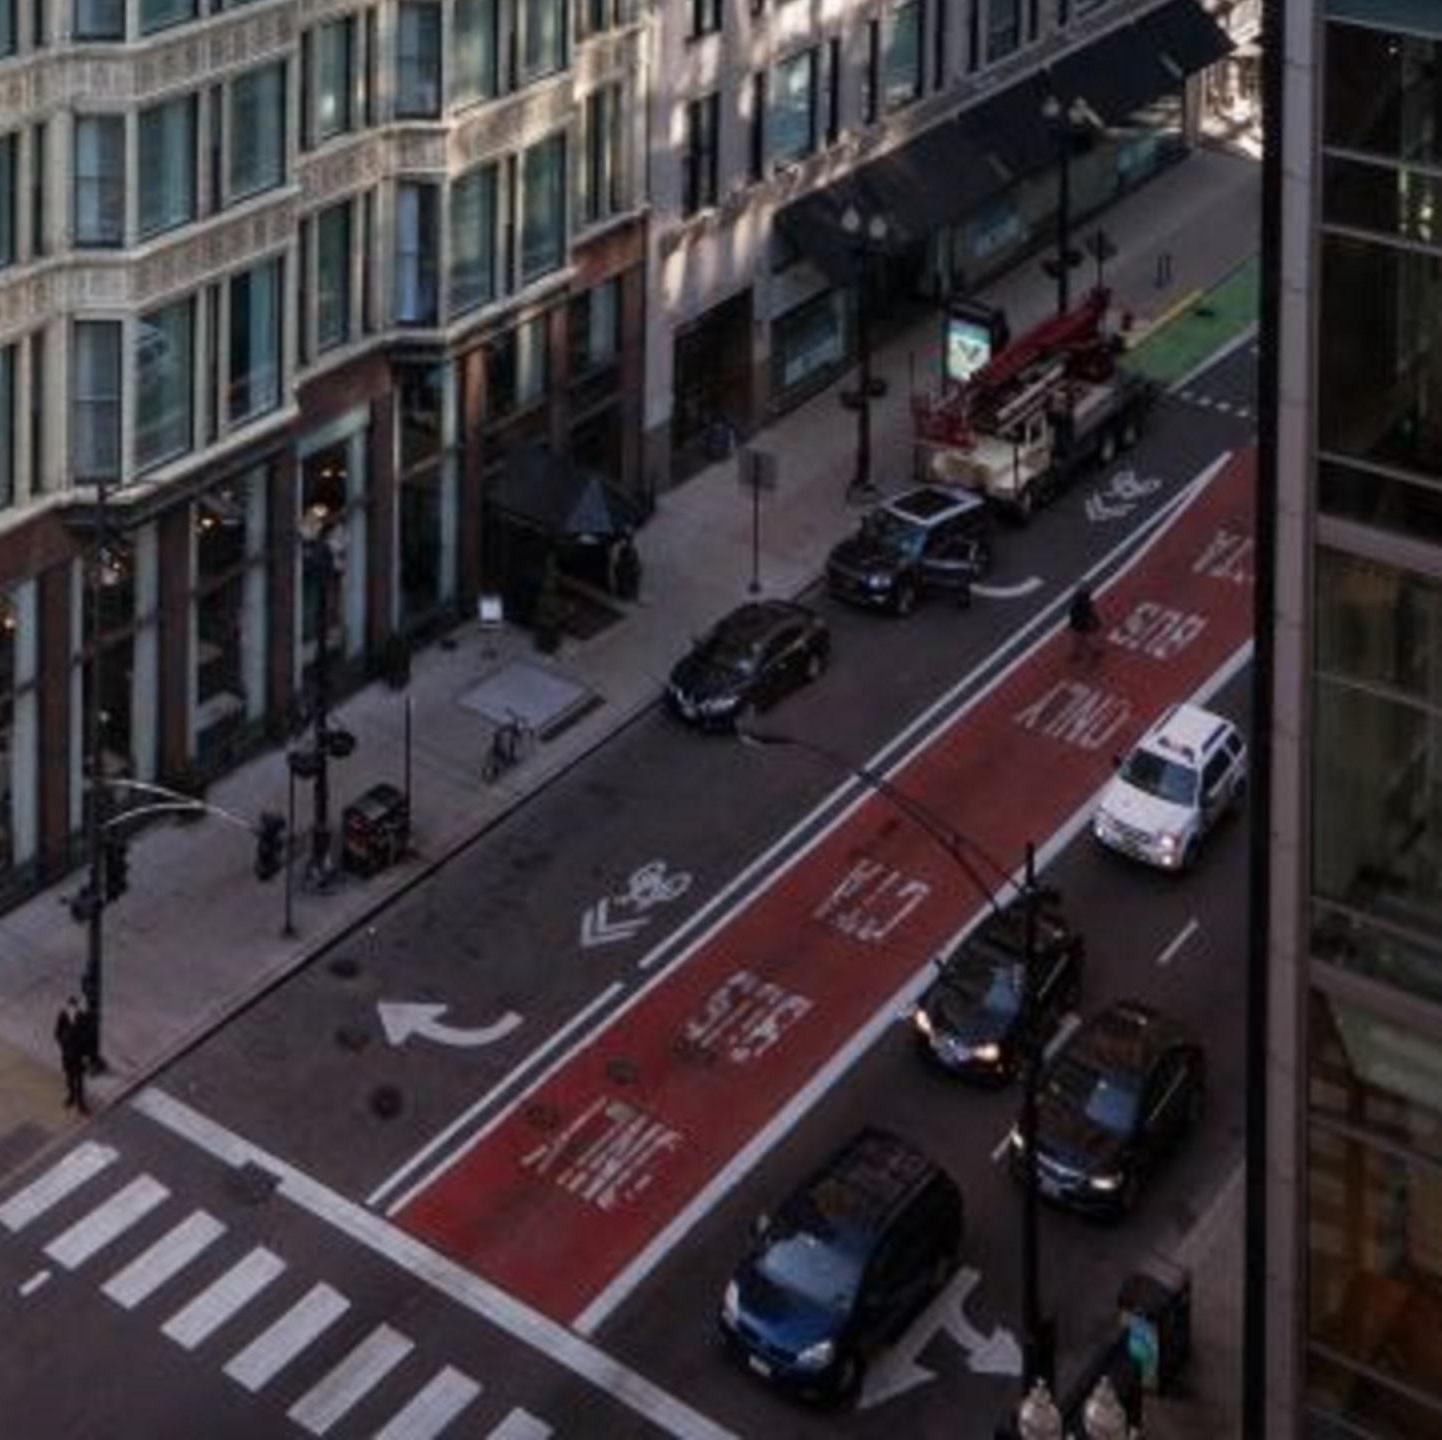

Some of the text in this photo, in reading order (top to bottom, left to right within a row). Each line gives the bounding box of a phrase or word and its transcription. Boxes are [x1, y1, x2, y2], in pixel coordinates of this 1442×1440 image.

[1192, 528, 1256, 583] TA
[1107, 601, 1209, 659] BUS
[1012, 681, 1132, 750] ONLY
